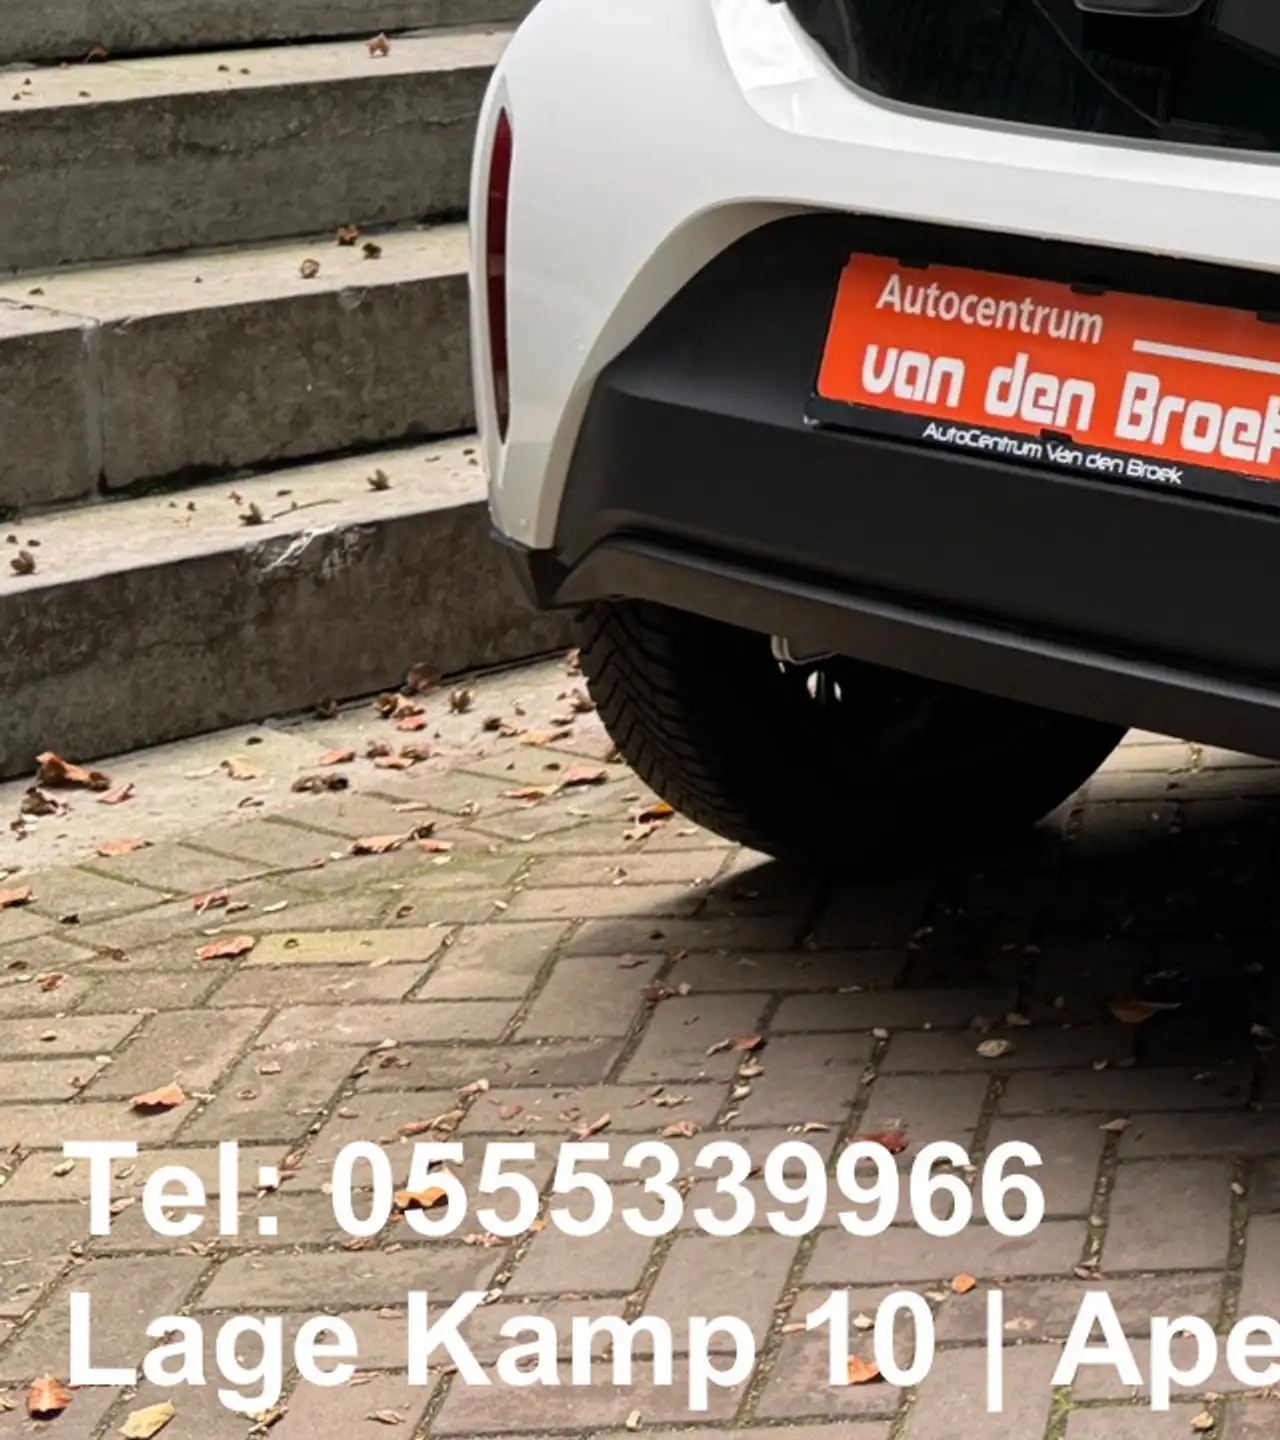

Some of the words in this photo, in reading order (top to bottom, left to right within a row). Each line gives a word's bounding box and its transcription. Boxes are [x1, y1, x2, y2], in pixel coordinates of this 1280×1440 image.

[876, 274, 1103, 345] Autocentrum
[861, 344, 966, 408] van
[984, 353, 1096, 431] den
[921, 421, 1043, 459] AutoCentrum
[1045, 442, 1082, 467] Van
[1085, 450, 1124, 474] den
[1126, 458, 1185, 486] Broek
